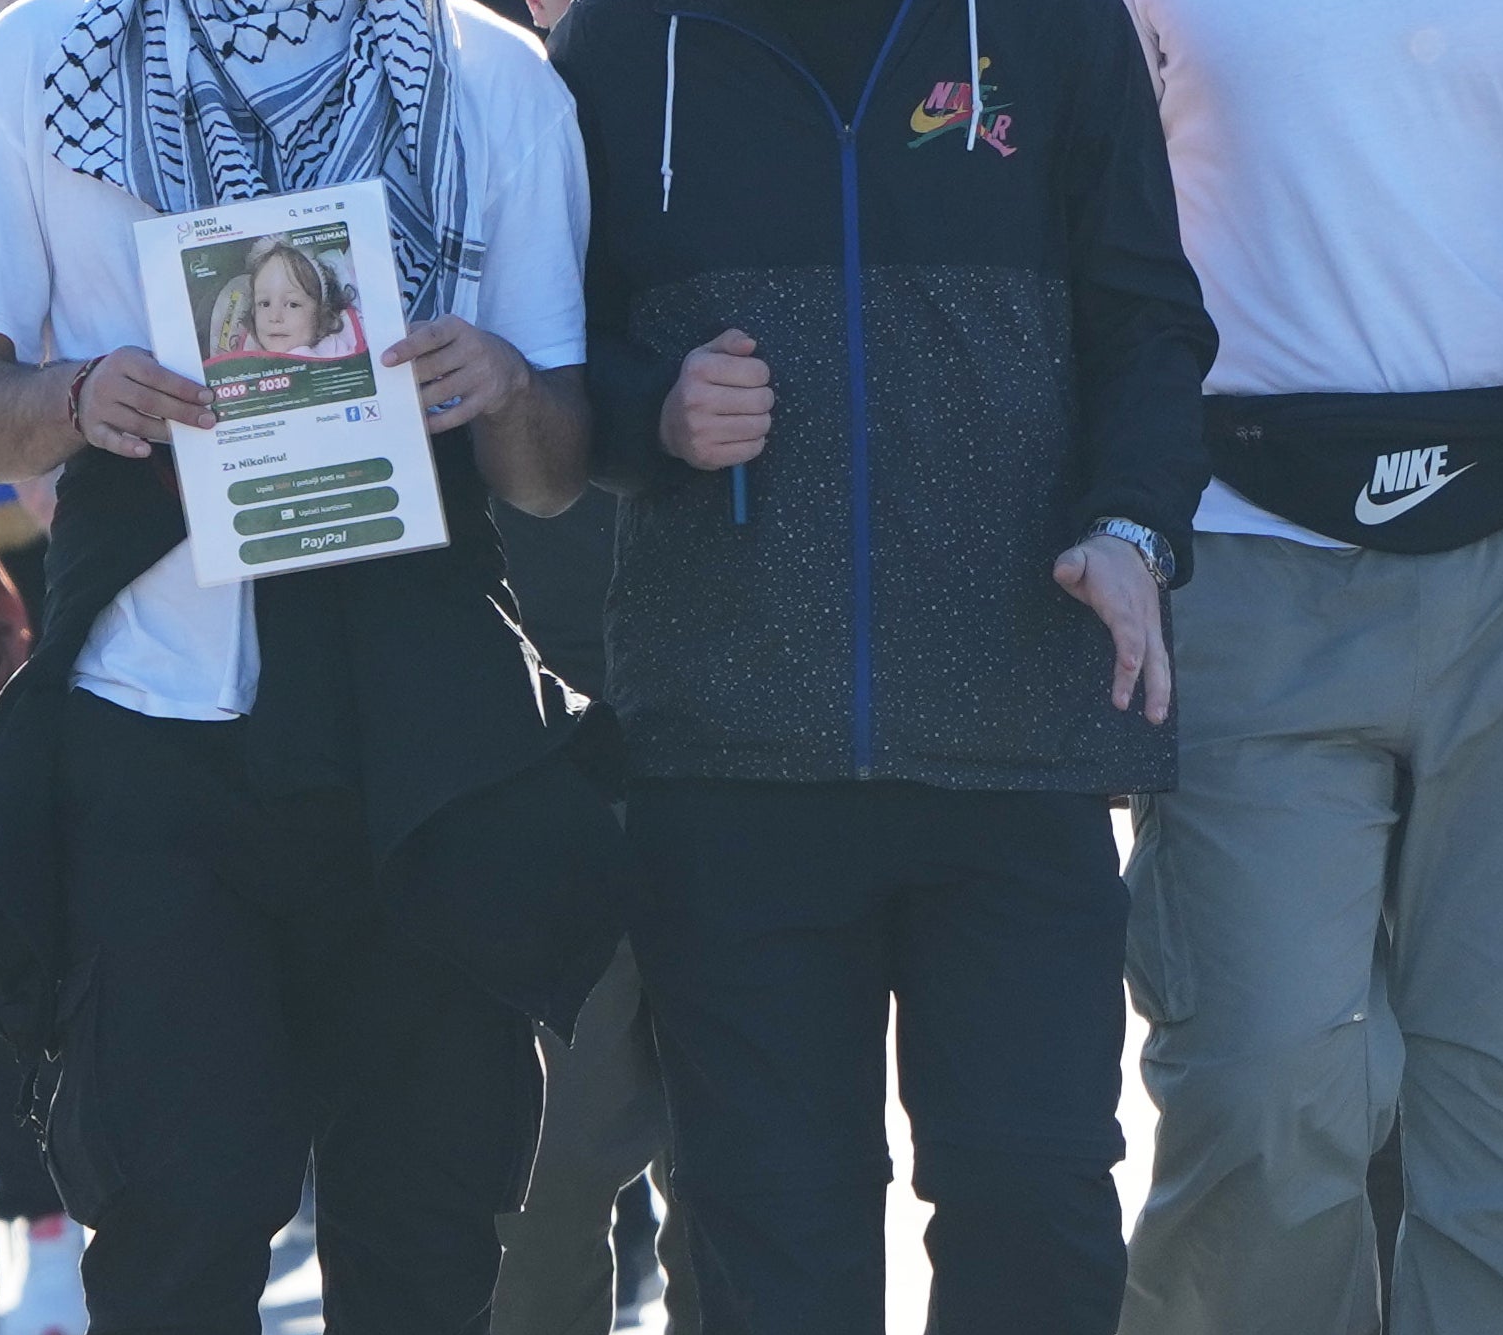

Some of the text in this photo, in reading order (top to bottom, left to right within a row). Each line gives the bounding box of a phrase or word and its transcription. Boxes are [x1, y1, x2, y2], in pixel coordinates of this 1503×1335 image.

[194, 217, 217, 228] BUDI
[195, 224, 232, 237] HUMAN
[292, 235, 314, 246] BUDI
[315, 228, 347, 243] HUMAN
[217, 377, 290, 399] 1069 3030
[222, 453, 288, 472] Za Nikolinu!
[1370, 444, 1449, 495] NIKE
[300, 530, 347, 549] PayPal
